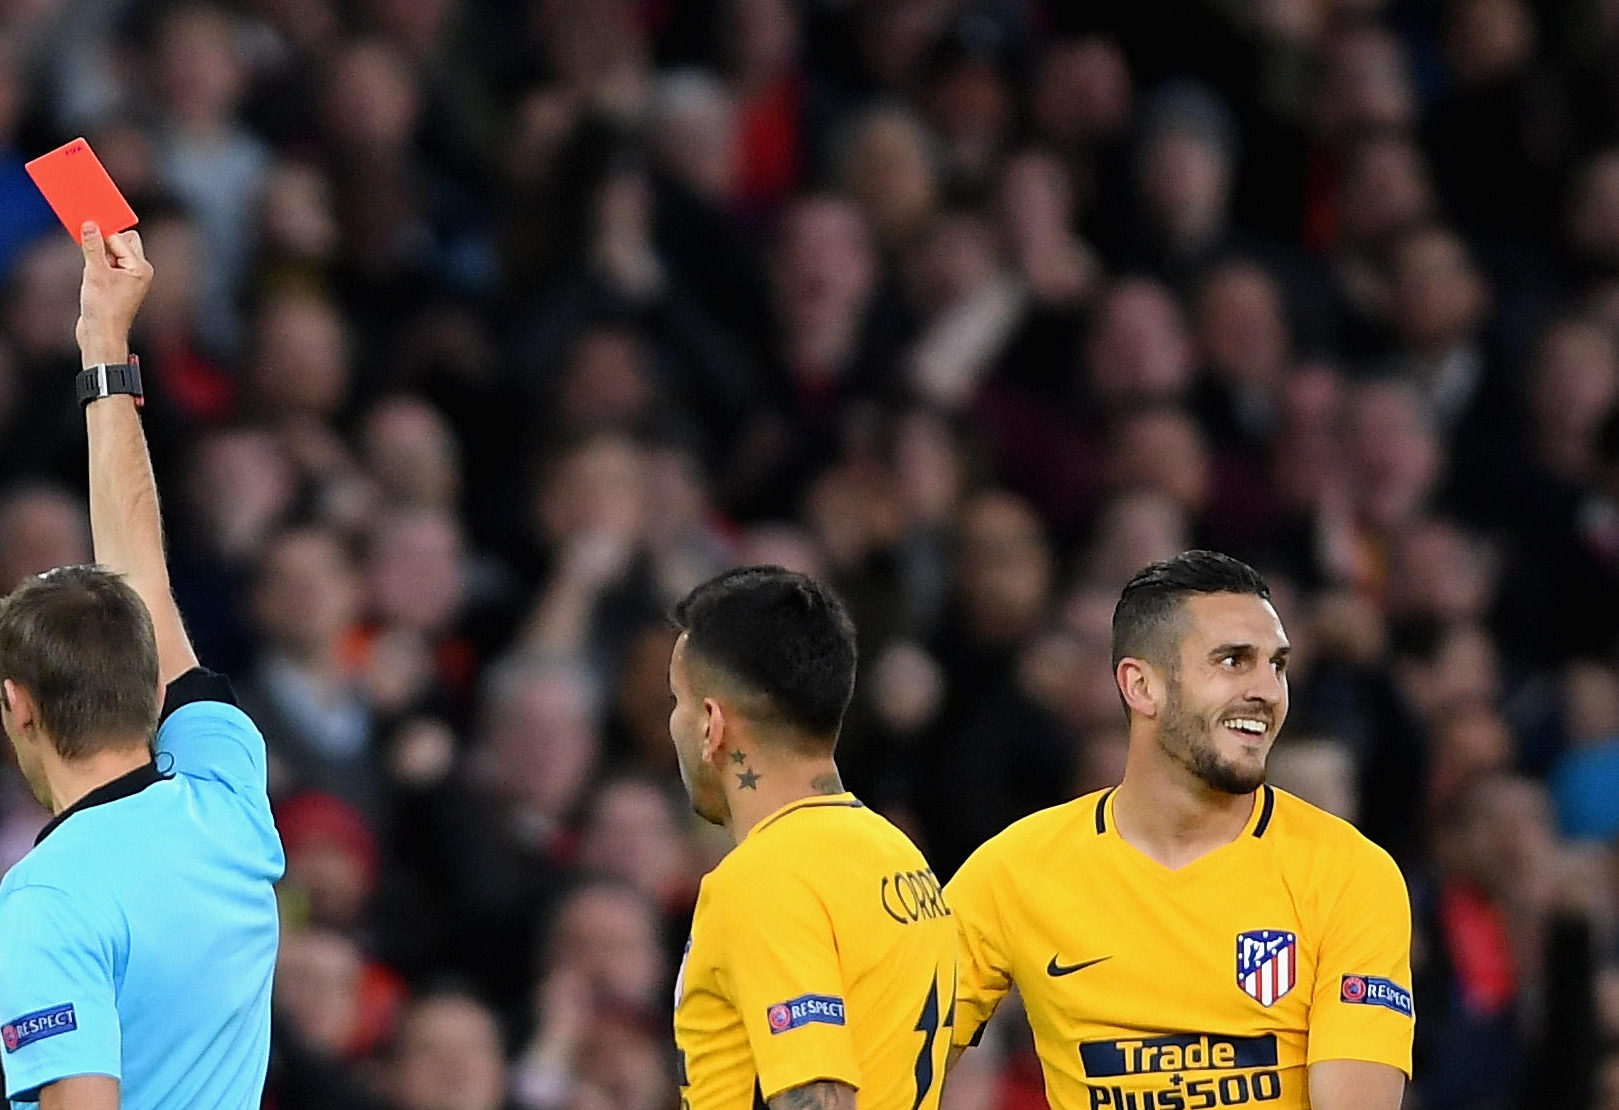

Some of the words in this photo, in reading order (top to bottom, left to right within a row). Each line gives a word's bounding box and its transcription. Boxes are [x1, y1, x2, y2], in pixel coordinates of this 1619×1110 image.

[791, 1000, 843, 1019] RESPECT
[1366, 984, 1411, 1010] RESPECT
[16, 1010, 73, 1039] RESPECT
[1116, 1034, 1235, 1073] Trade
